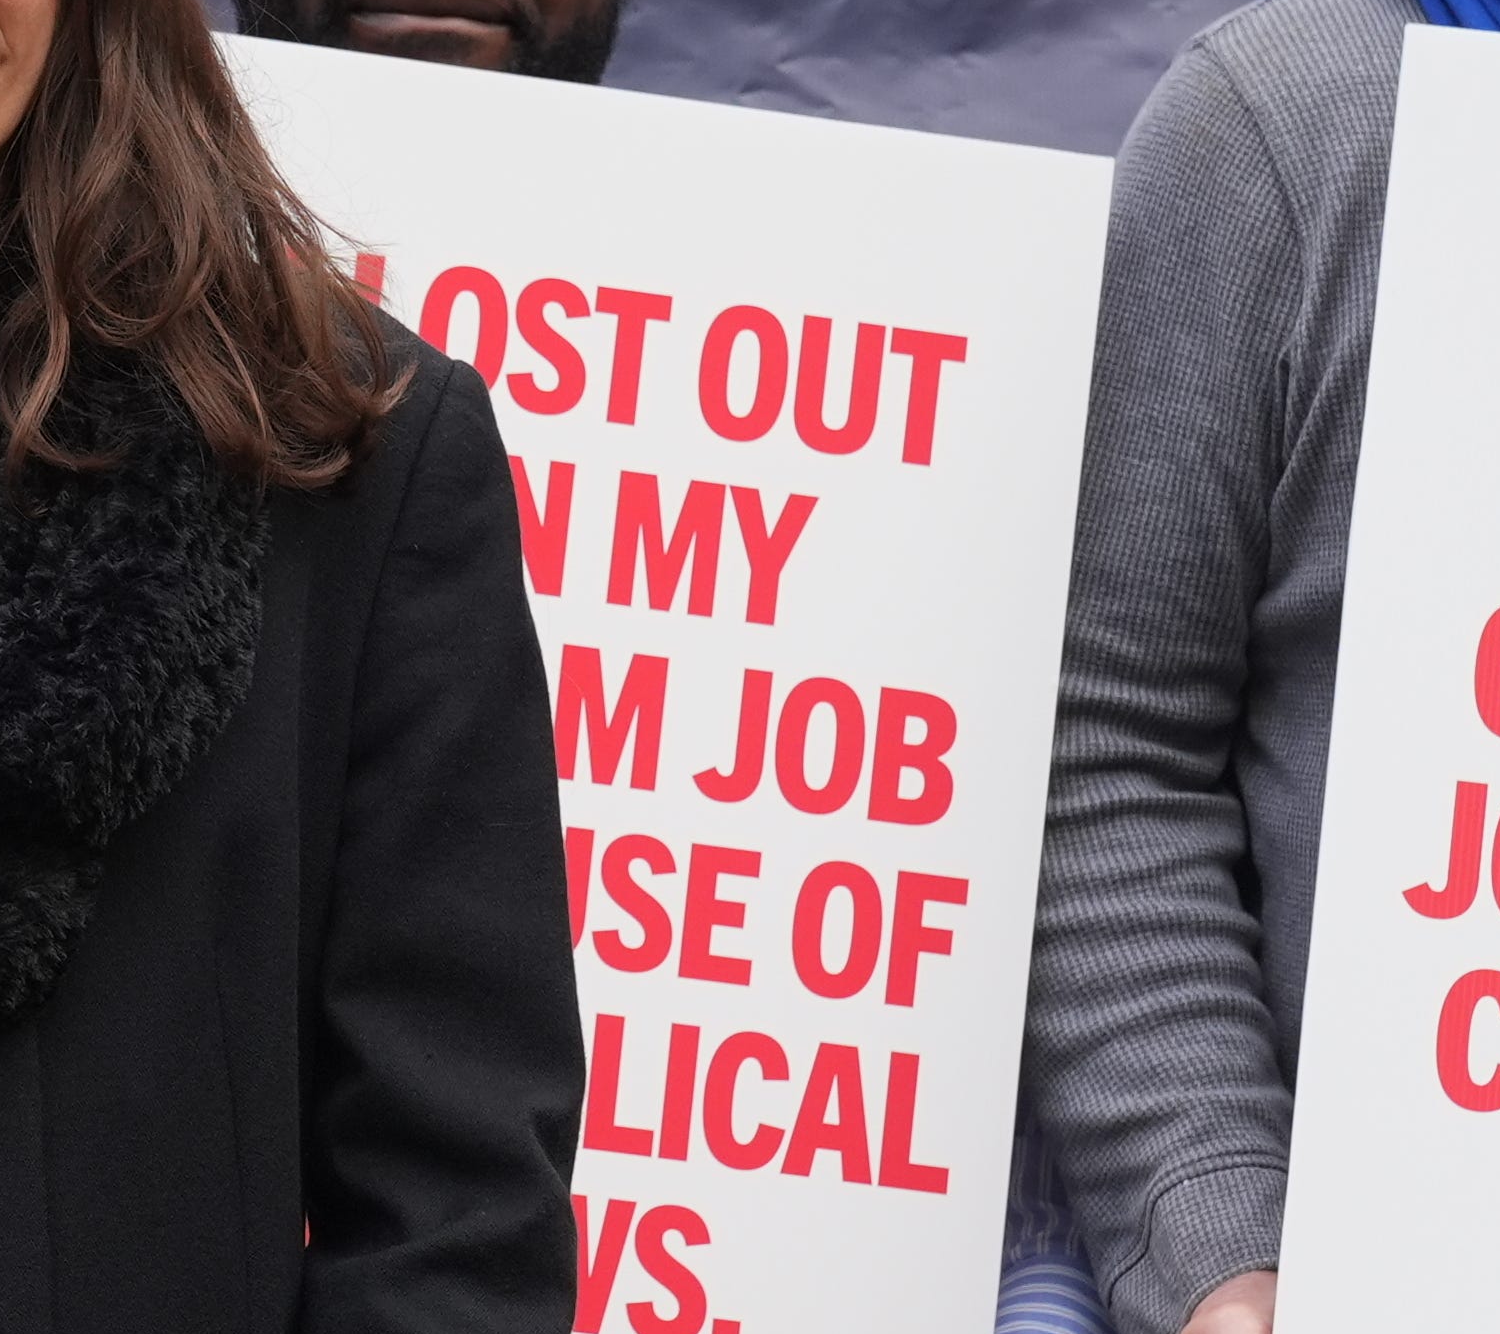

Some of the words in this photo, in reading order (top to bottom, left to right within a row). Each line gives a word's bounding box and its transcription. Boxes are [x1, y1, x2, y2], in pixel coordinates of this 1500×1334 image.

[354, 252, 674, 426] OST
[697, 303, 969, 466] OUT
[605, 469, 819, 626] MY
[691, 667, 958, 826] JOB
[790, 859, 970, 1008] OF
[581, 1012, 950, 1195] LICAL
